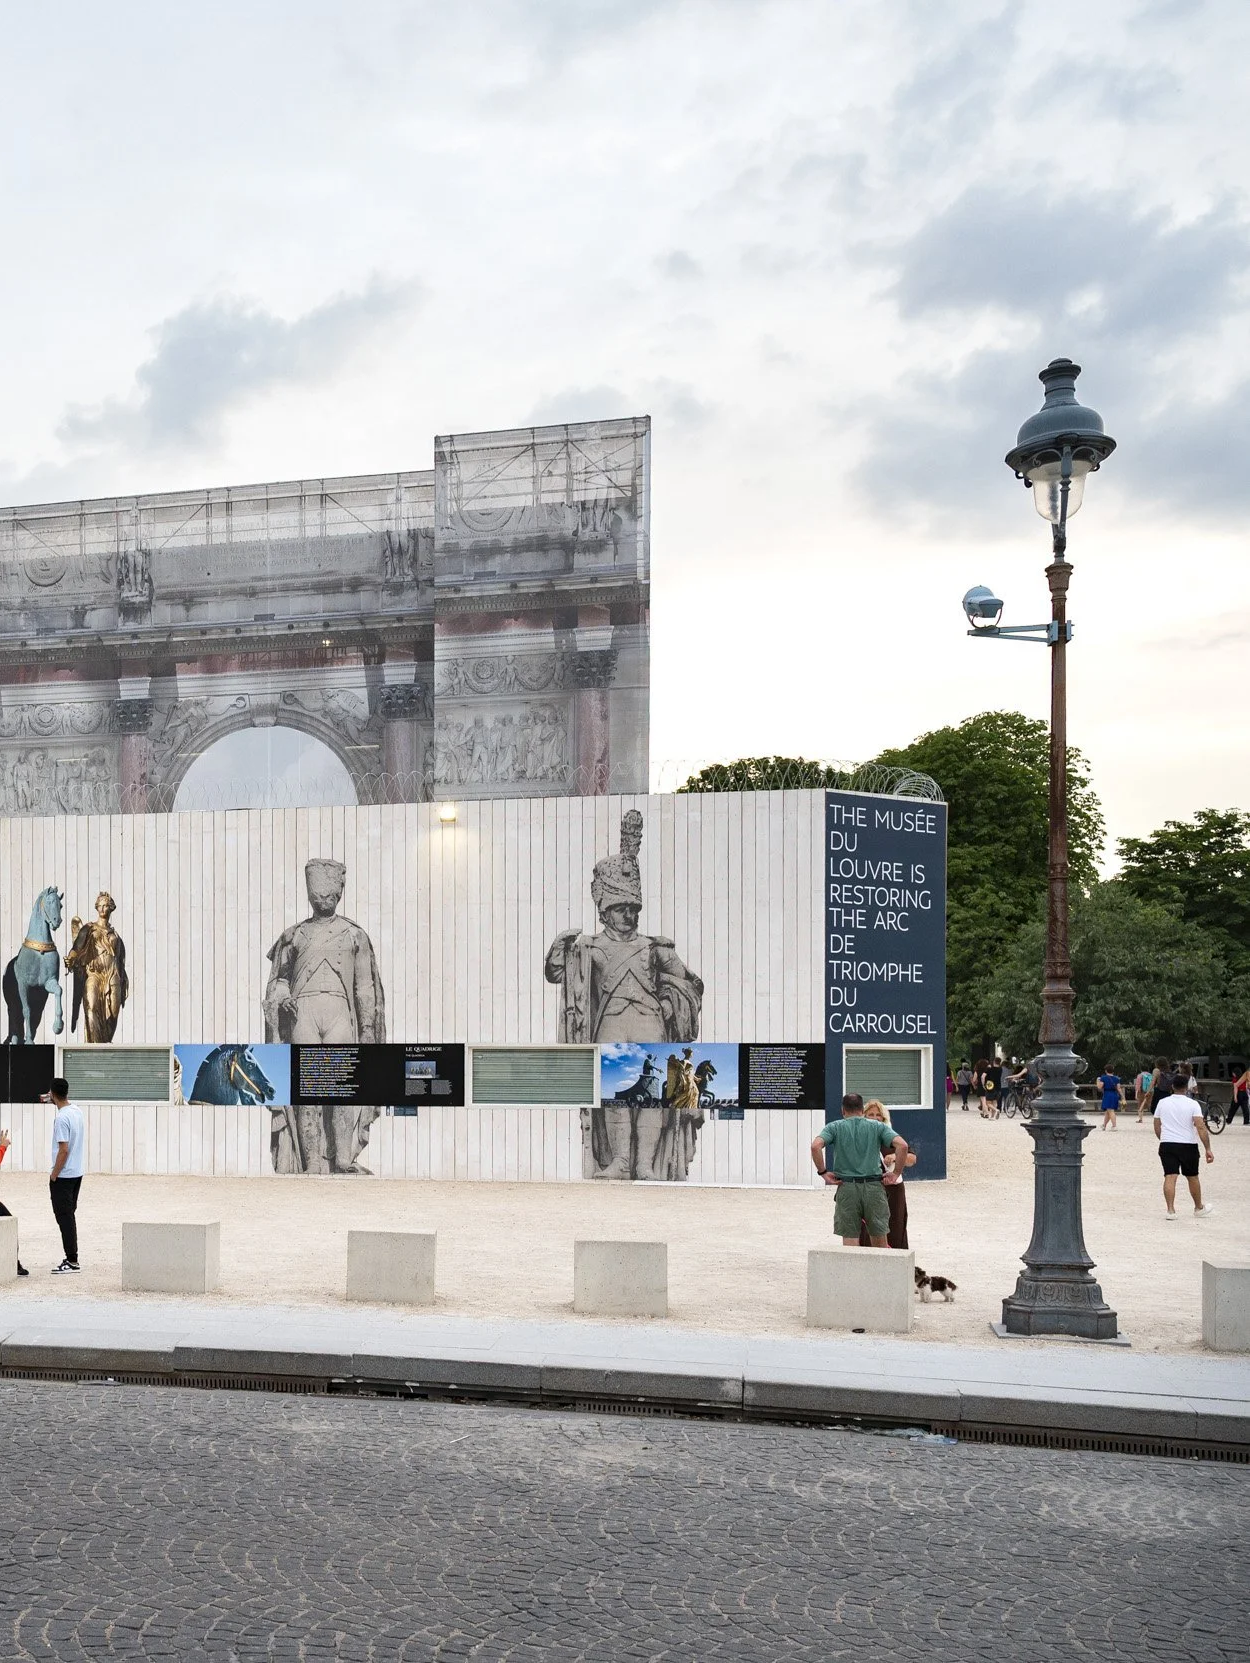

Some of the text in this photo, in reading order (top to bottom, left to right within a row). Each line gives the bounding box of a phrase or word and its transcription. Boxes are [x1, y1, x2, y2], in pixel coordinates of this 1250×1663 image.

[829, 804, 937, 834] THE MUSÉE
[830, 831, 858, 852] DU
[830, 857, 926, 884] LOUVRE IS
[830, 883, 932, 910] RESTORING
[829, 907, 909, 931] THE ARC
[830, 934, 855, 954] DE
[829, 960, 923, 983] TRIOMPHE
[830, 986, 857, 1007] DU
[829, 1012, 937, 1034] CARROUSEL
